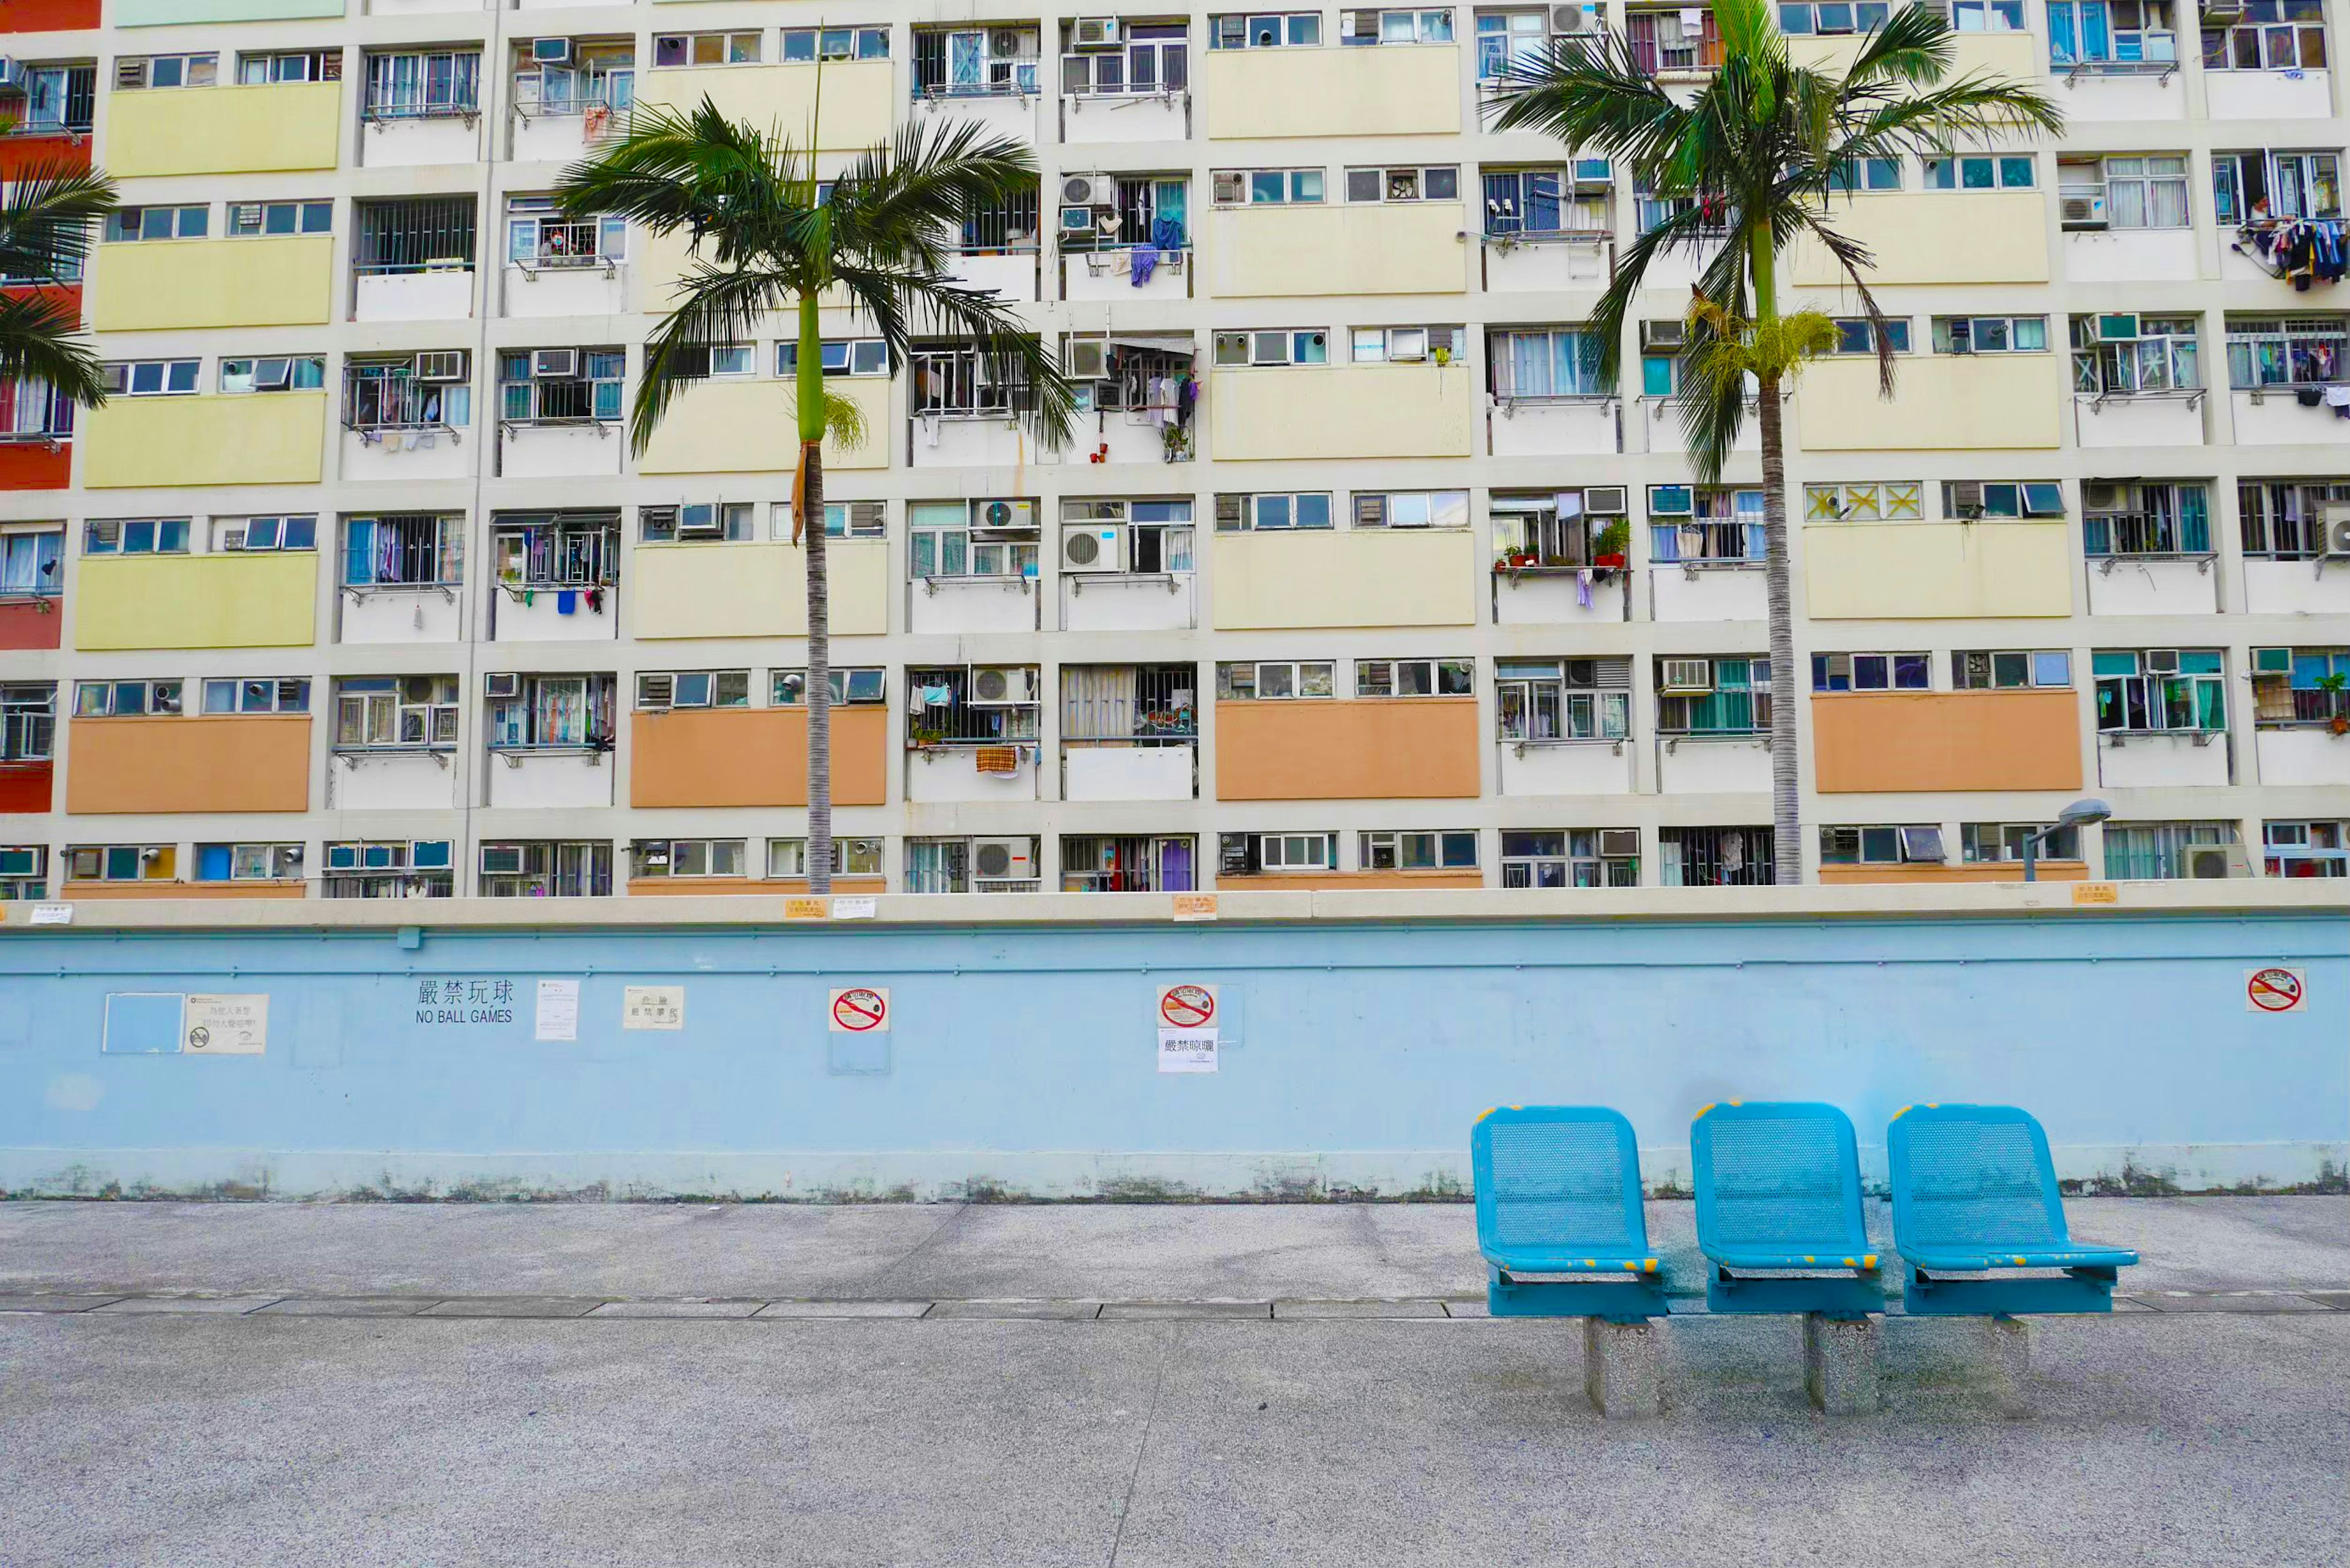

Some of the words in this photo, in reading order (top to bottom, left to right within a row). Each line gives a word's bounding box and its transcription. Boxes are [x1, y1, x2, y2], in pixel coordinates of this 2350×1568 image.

[417, 980, 513, 1005] 嚴禁玩球
[416, 1010, 433, 1023] NO
[438, 1010, 466, 1023] BALL
[471, 1010, 512, 1023] GAMES
[1165, 1040, 1214, 1052] 嚴禁晾曬
